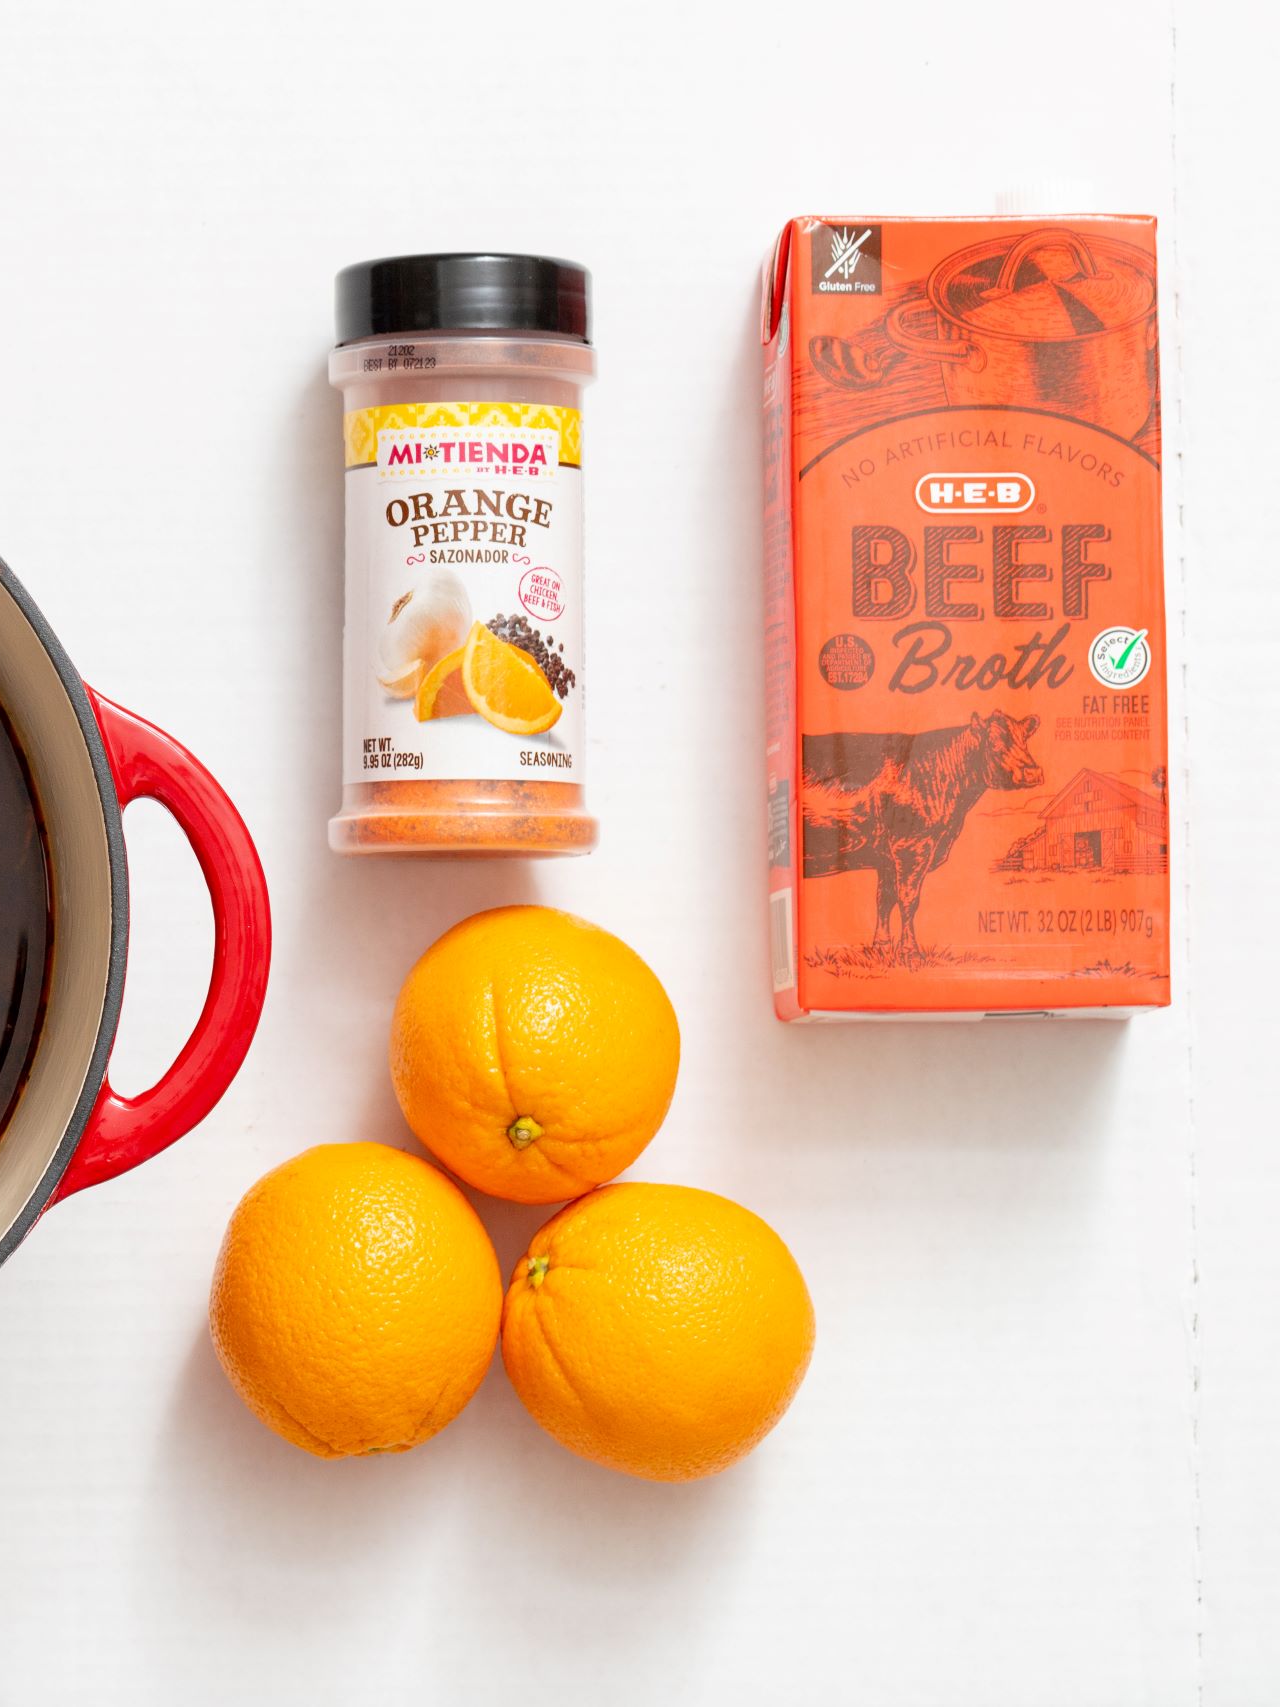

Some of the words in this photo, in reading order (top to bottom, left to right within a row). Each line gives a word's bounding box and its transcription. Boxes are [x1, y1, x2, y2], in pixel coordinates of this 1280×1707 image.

[819, 281, 852, 292] Gluten
[854, 281, 876, 292] Free
[388, 345, 415, 356] 21202
[363, 360, 383, 371] BEST
[388, 359, 398, 370] BY
[403, 357, 436, 369] 072123
[388, 444, 422, 466] MI
[439, 442, 547, 465] TIENDA
[841, 458, 876, 489] NO
[885, 430, 1013, 466] ARTIFICIAL
[1023, 433, 1125, 488] FLAVORS
[385, 489, 553, 528] ORANGE
[410, 521, 527, 547] PEPPER
[430, 550, 509, 564] SAZONADOR
[852, 524, 1112, 621] BEEF
[531, 574, 550, 586] GREAT
[551, 580, 561, 591] ON
[524, 594, 540, 606] BEEF
[547, 600, 560, 612] FISH
[835, 636, 858, 648] U.S.
[1098, 637, 1129, 660] Select
[887, 621, 1074, 694] Broth
[1082, 696, 1107, 714] FAT
[1113, 696, 1149, 714] FREE
[1056, 717, 1073, 728] SEE
[1074, 717, 1121, 727] NUTRITION
[1123, 717, 1150, 727] PANEL
[1055, 730, 1072, 741] FOR
[1074, 730, 1109, 740] SODIUM
[1111, 729, 1150, 740] CONTENT
[363, 738, 376, 753] NET
[378, 738, 394, 752] WT.
[363, 755, 379, 769] 9.95
[381, 753, 391, 768] OZ
[394, 752, 423, 770] (282g)
[520, 751, 572, 769] SEASONING
[978, 911, 1005, 932] NET
[1008, 911, 1031, 932] WT.
[1038, 911, 1053, 932] 32
[1057, 911, 1077, 933] OZ
[1080, 910, 1093, 936] (2
[1097, 910, 1117, 936] LB)
[1120, 909, 1153, 937] 907g
